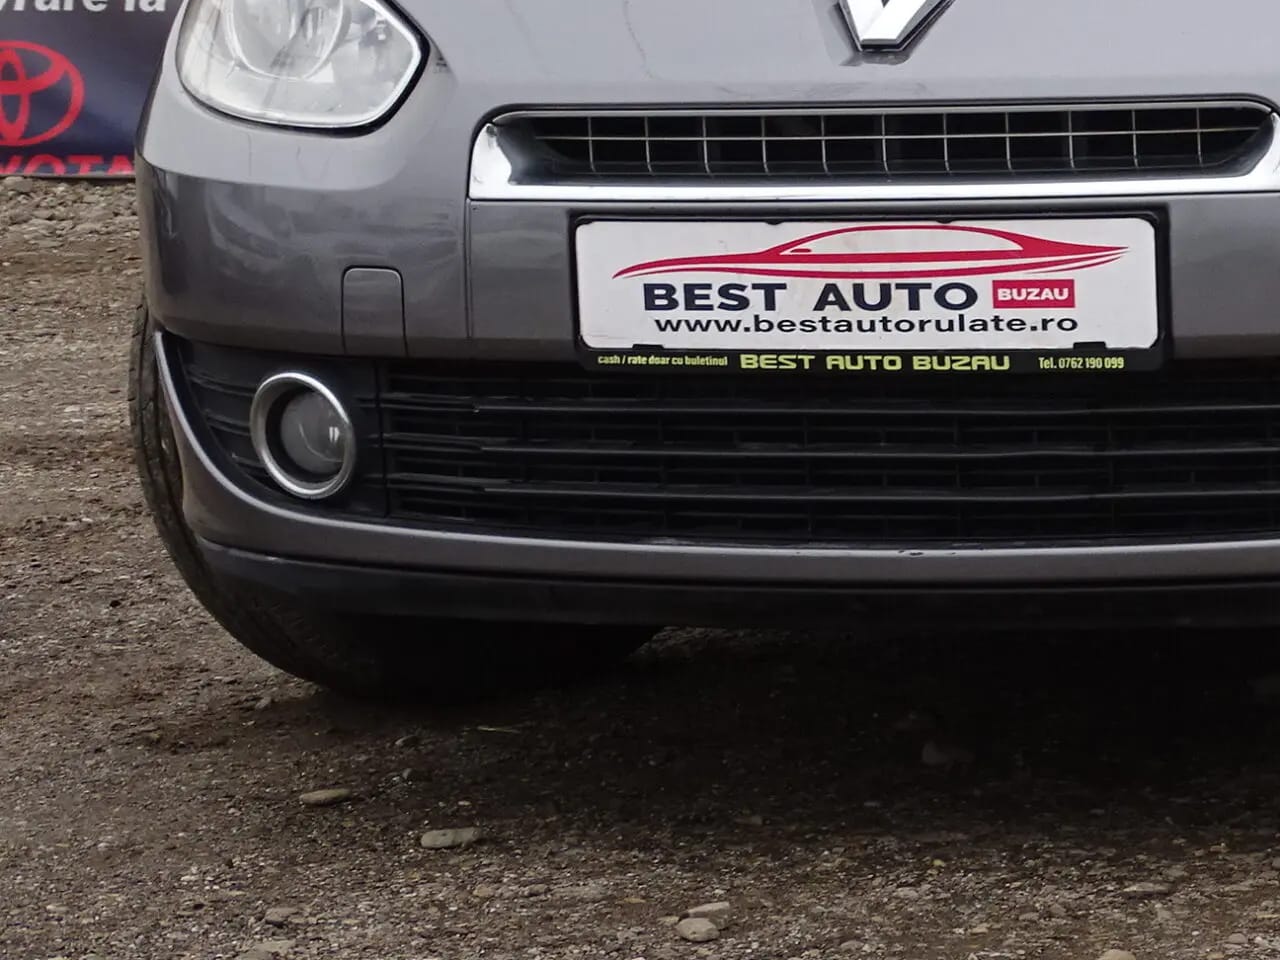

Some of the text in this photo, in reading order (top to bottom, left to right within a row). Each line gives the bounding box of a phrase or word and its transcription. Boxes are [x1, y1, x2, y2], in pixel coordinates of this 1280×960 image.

[643, 282, 979, 312] BEST AUTO
[997, 287, 1069, 301] BUZAU
[654, 313, 1079, 333] www.bestautorulate.ro
[598, 355, 620, 365] cash
[627, 355, 647, 365] rate
[648, 355, 671, 365] doar
[671, 356, 683, 365] cu
[685, 355, 728, 366] buletinul
[739, 353, 1010, 371] BEST AUTO BUZAU
[1038, 356, 1125, 369] Tel. 0762 190 099
